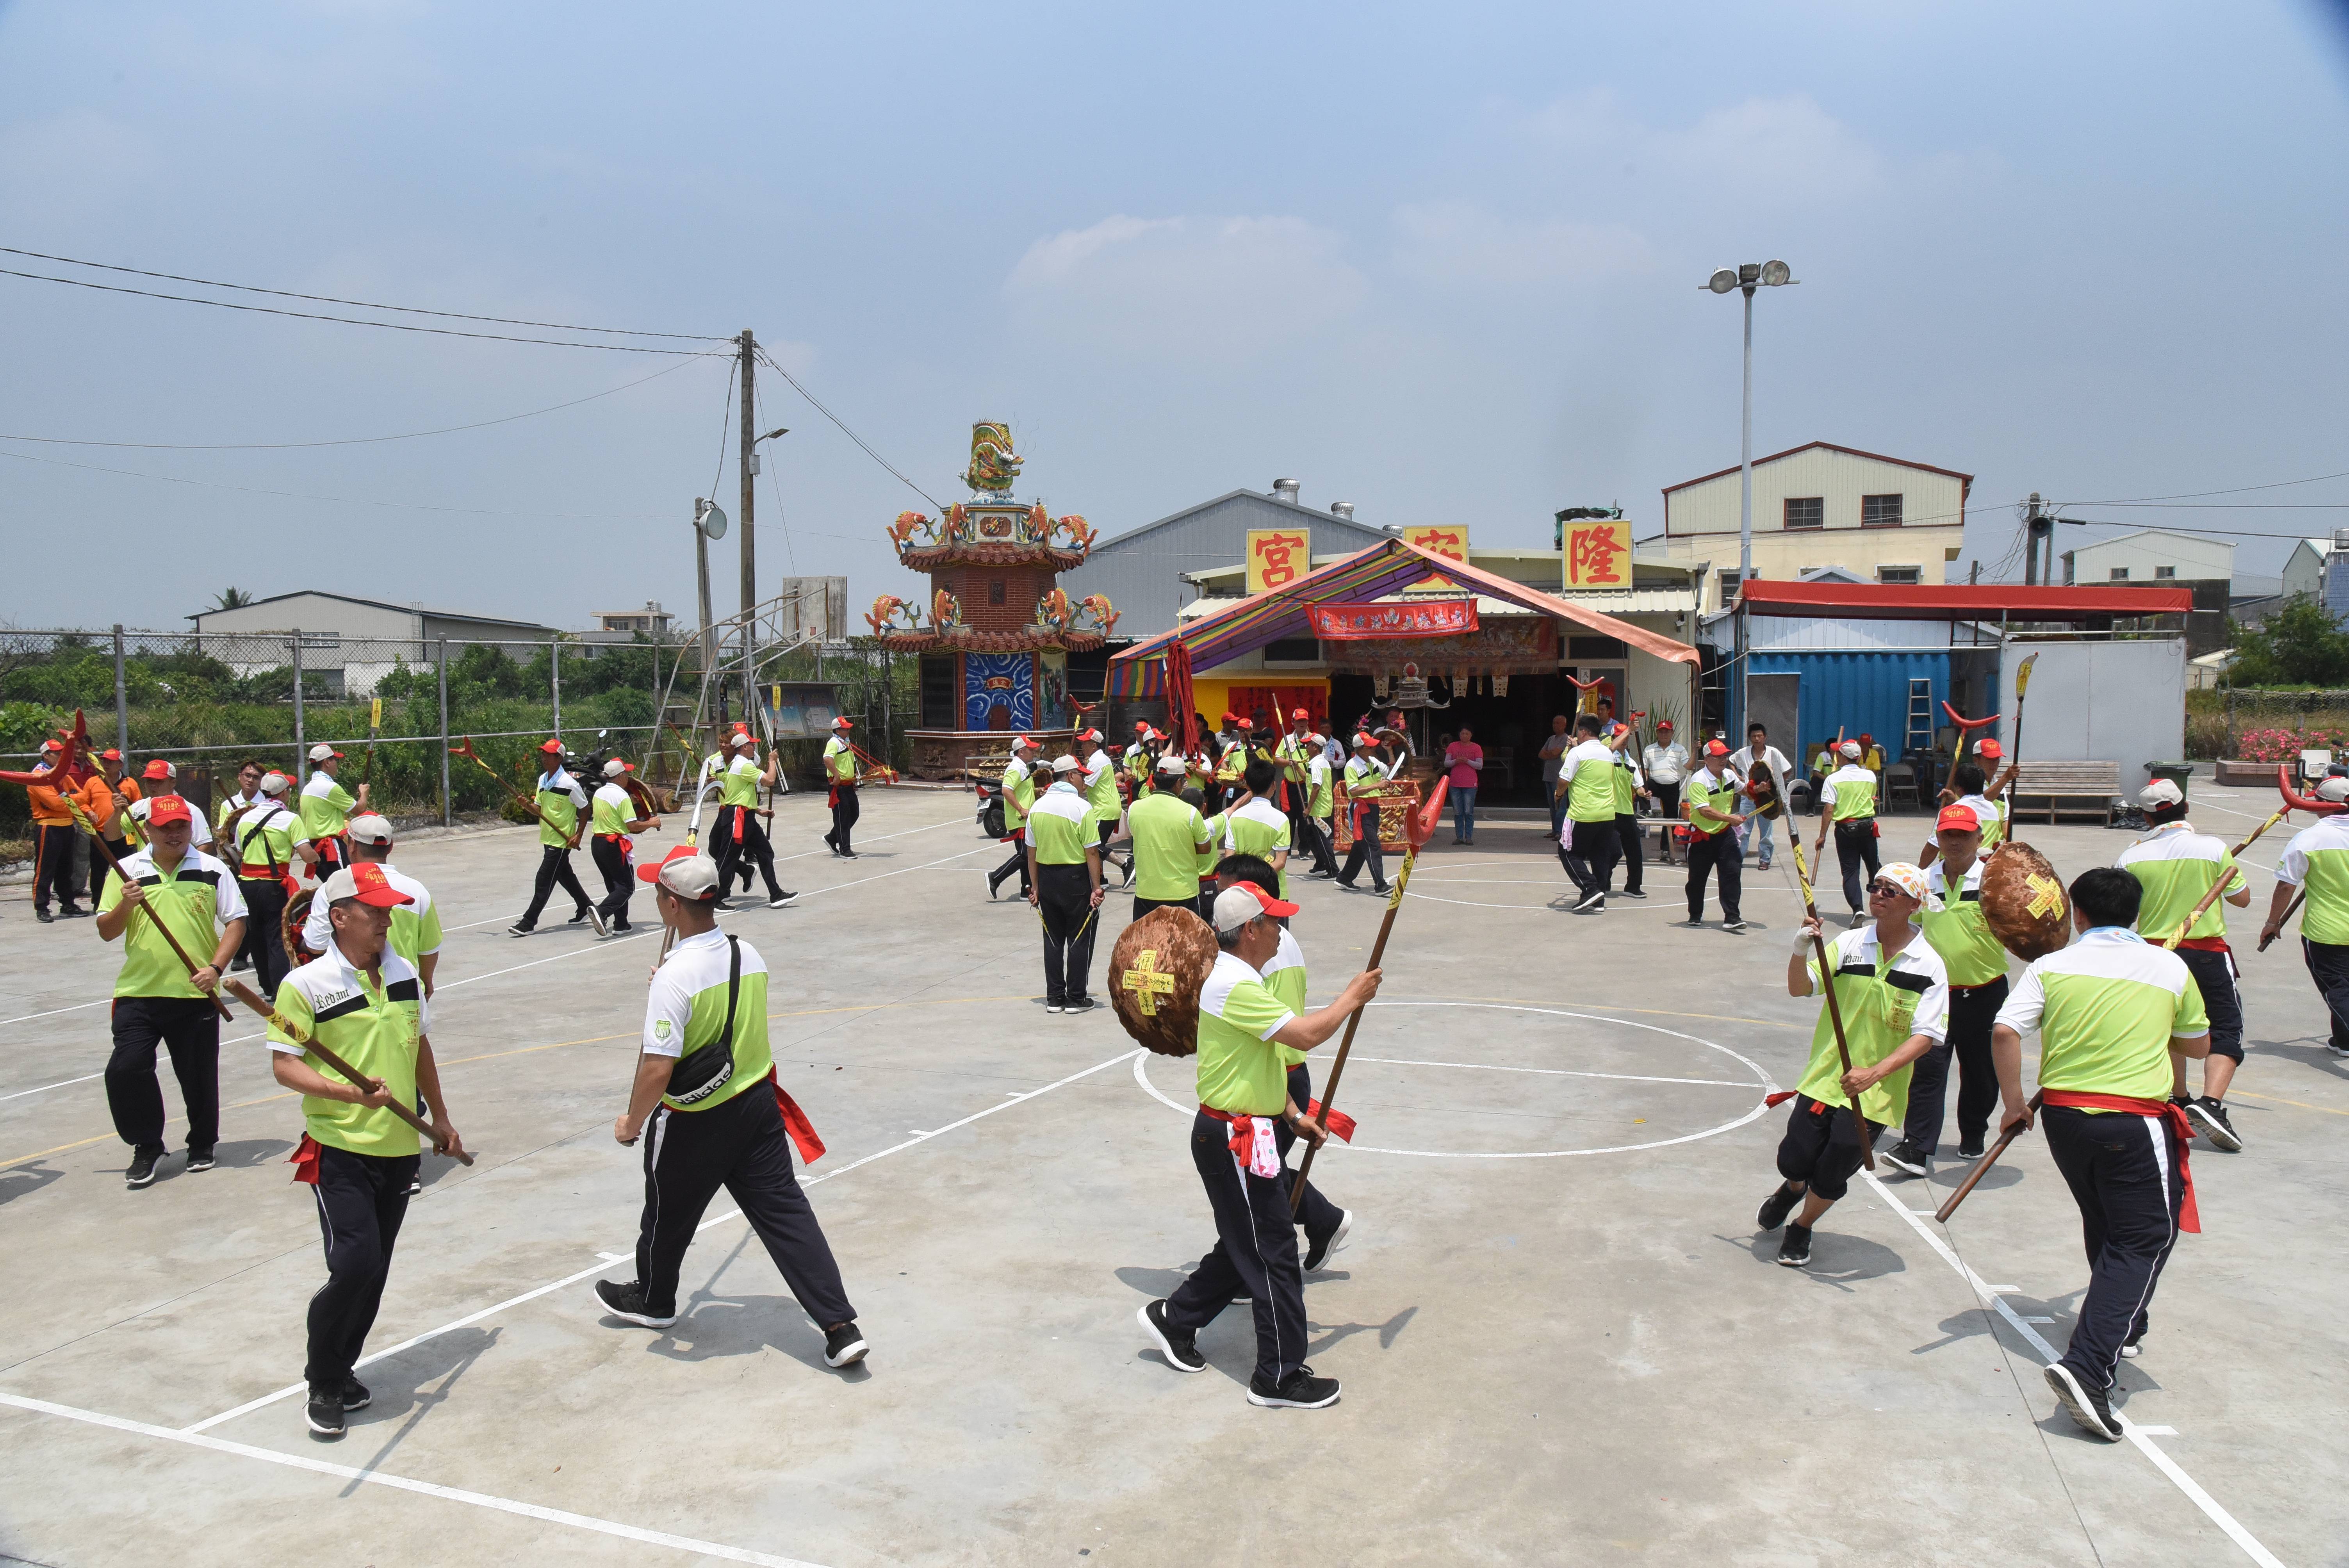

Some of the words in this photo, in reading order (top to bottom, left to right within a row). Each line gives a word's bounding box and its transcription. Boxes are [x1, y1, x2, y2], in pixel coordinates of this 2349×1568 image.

[1256, 533, 1304, 588] 宮
[1414, 529, 1463, 586] 安
[1570, 525, 1627, 584] 隆
[673, 1070, 731, 1105] adidas
